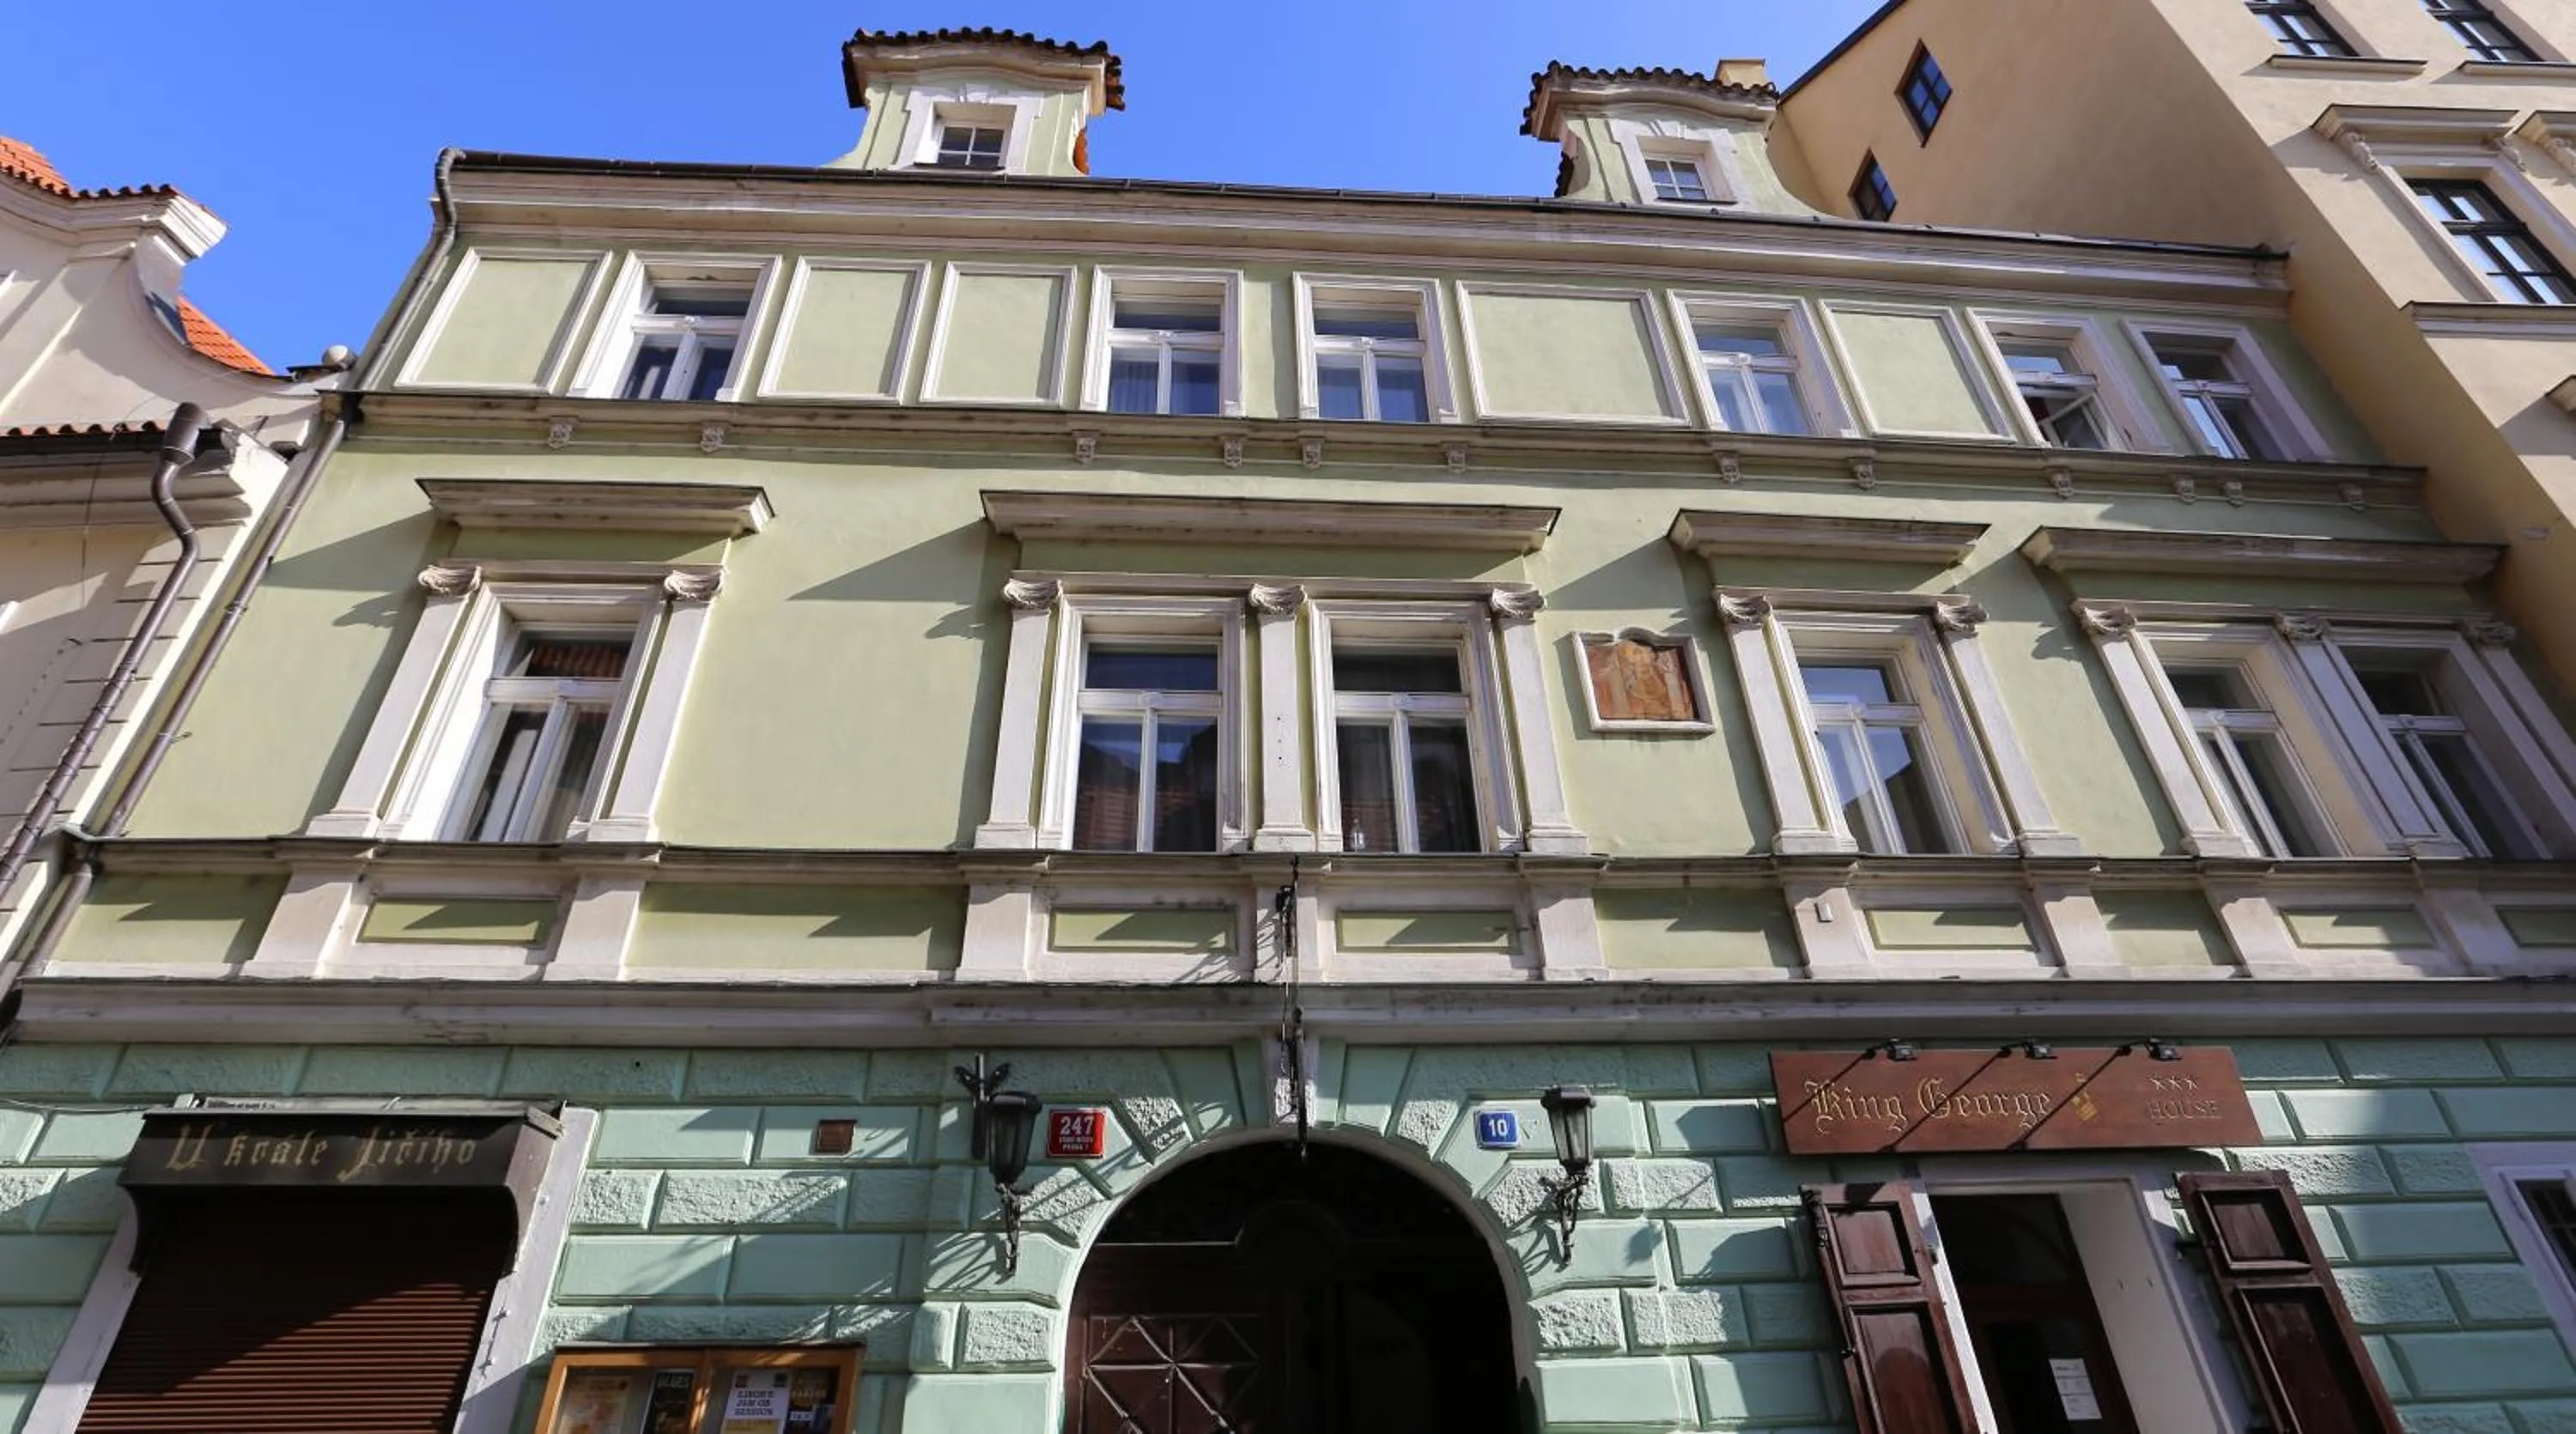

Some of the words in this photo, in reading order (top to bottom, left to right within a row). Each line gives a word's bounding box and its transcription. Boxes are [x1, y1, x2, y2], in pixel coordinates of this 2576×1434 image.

[1804, 1078, 1909, 1134] King
[1916, 1077, 2051, 1131] George
[1059, 1115, 1095, 1135] 247
[1488, 1118, 1508, 1137] 10
[165, 1122, 215, 1171] U
